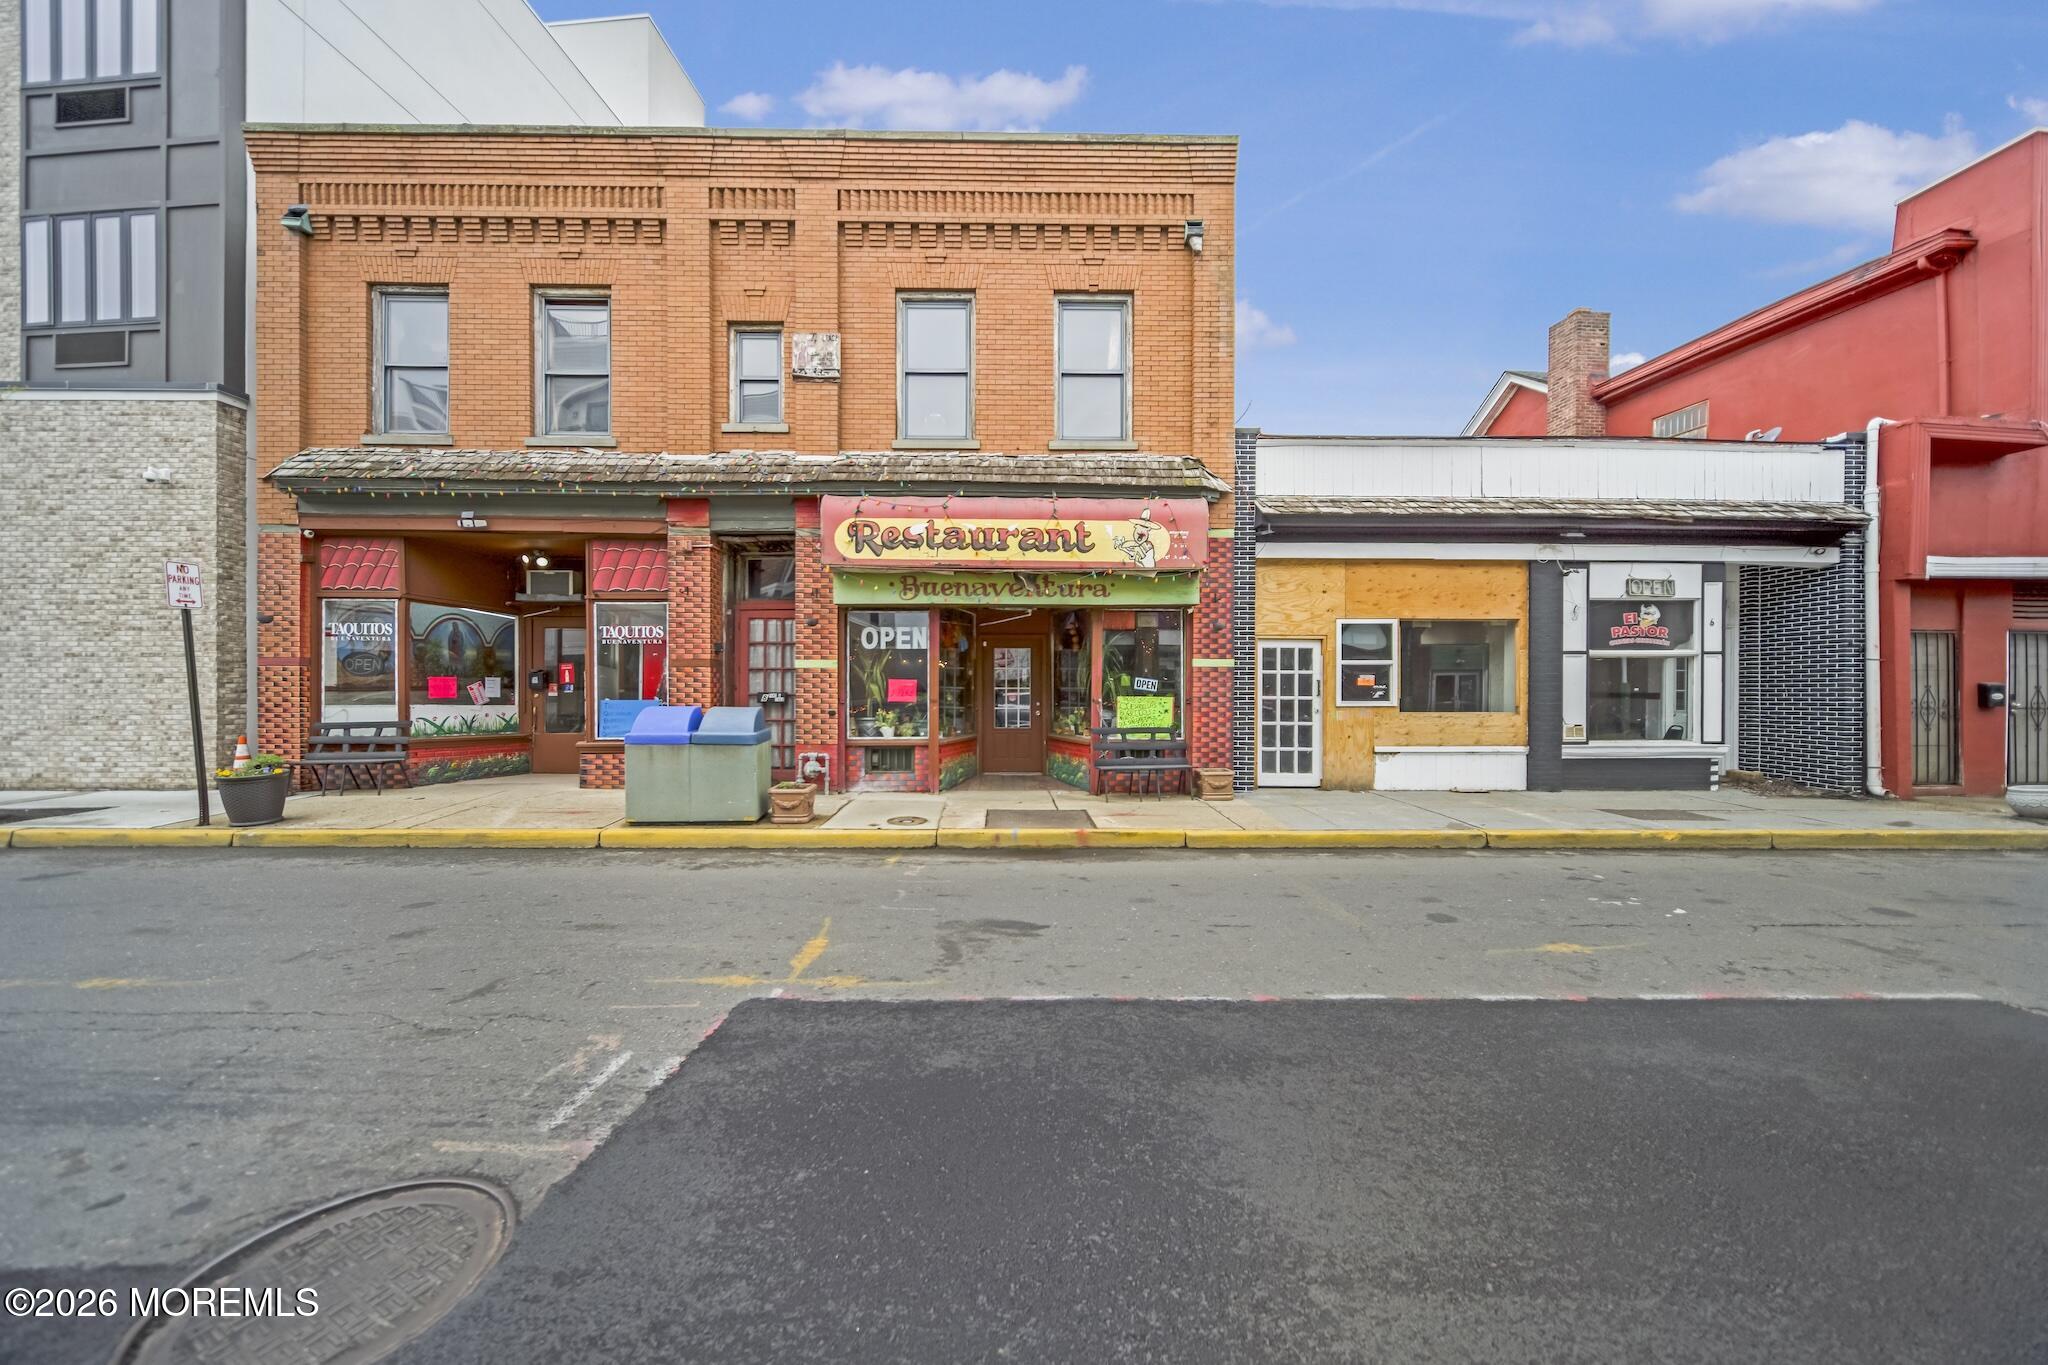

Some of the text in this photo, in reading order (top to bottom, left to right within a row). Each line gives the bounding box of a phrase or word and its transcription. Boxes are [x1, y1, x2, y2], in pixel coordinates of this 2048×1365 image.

[848, 520, 1095, 557] Restaurant
[176, 564, 190, 575] NO
[168, 575, 200, 586] PARKING
[1630, 579, 1675, 595] OPEN
[328, 622, 393, 636] TAQUITOS
[599, 625, 664, 639] TAQUITOS
[1610, 625, 1669, 639] PASTOR
[861, 626, 927, 650] OPEN
[345, 659, 383, 672] OPEN
[1136, 679, 1157, 690] OPEN
